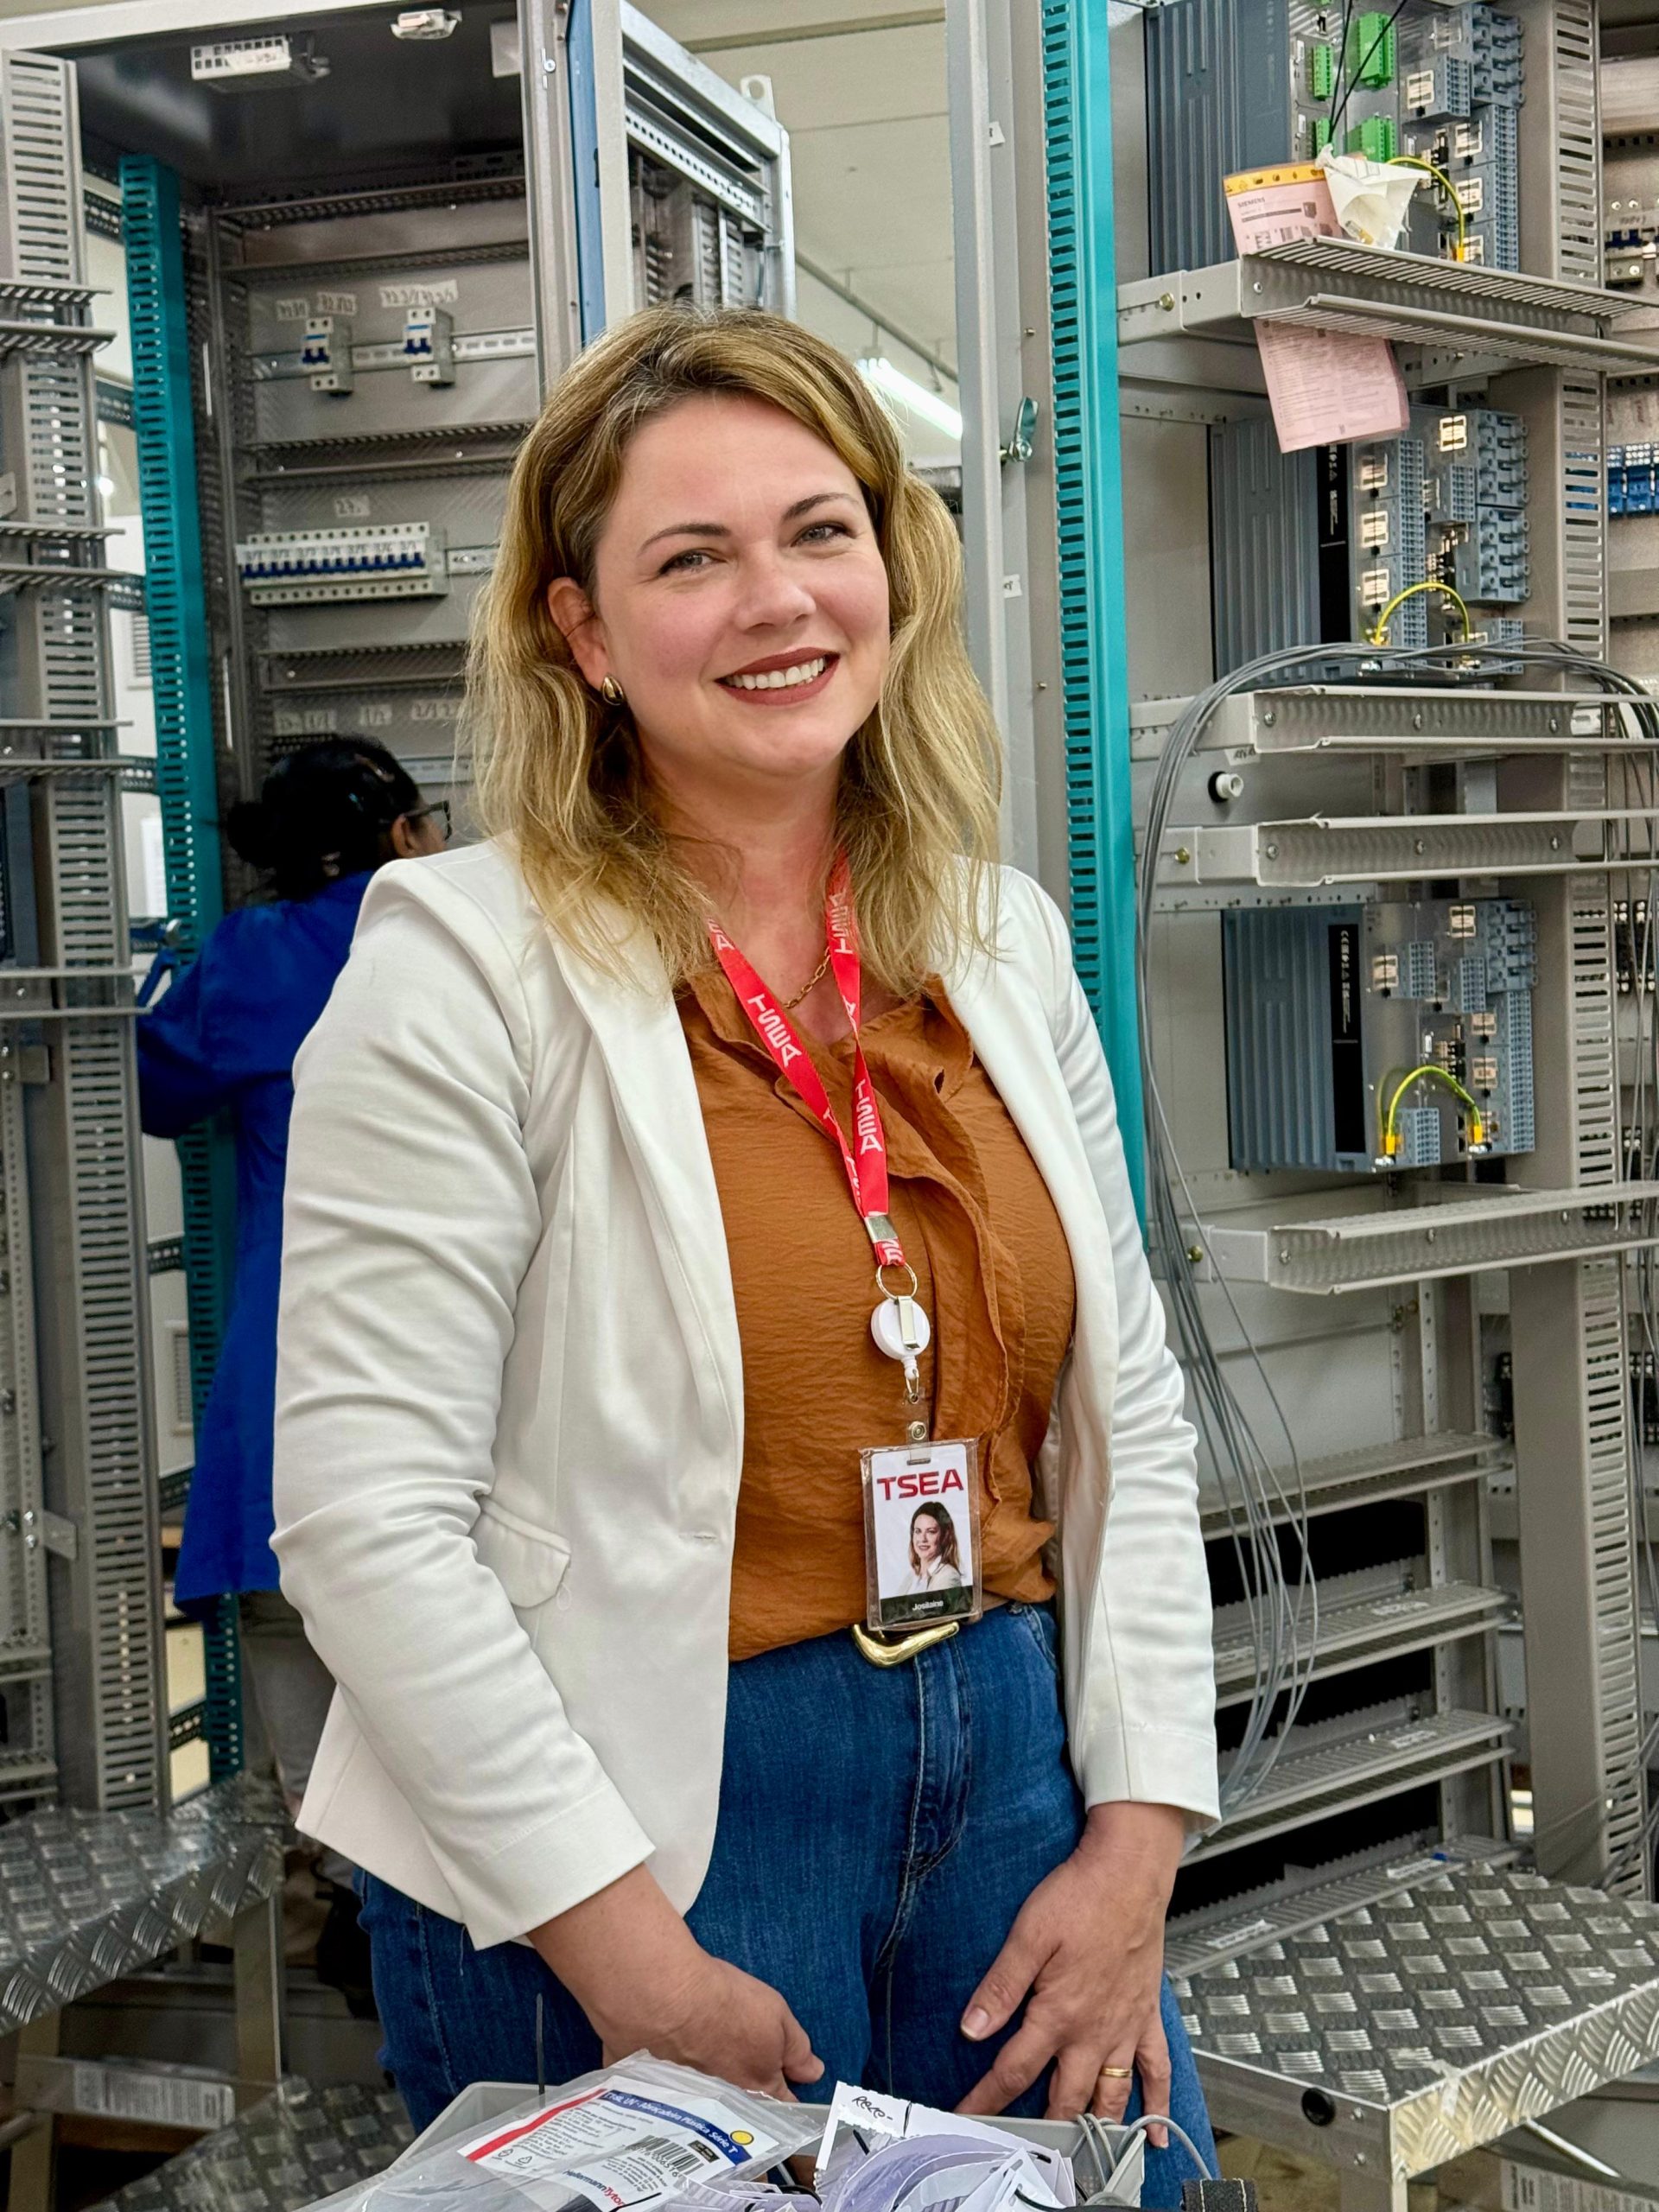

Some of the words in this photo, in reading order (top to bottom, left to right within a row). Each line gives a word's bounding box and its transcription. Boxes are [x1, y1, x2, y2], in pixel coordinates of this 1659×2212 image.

[747, 993, 803, 1069] TSEA
[855, 1078, 884, 1156] TSEA
[876, 1469, 965, 1502] TSEA
[709, 2131, 730, 2148] Série
[728, 2145, 739, 2154] T
